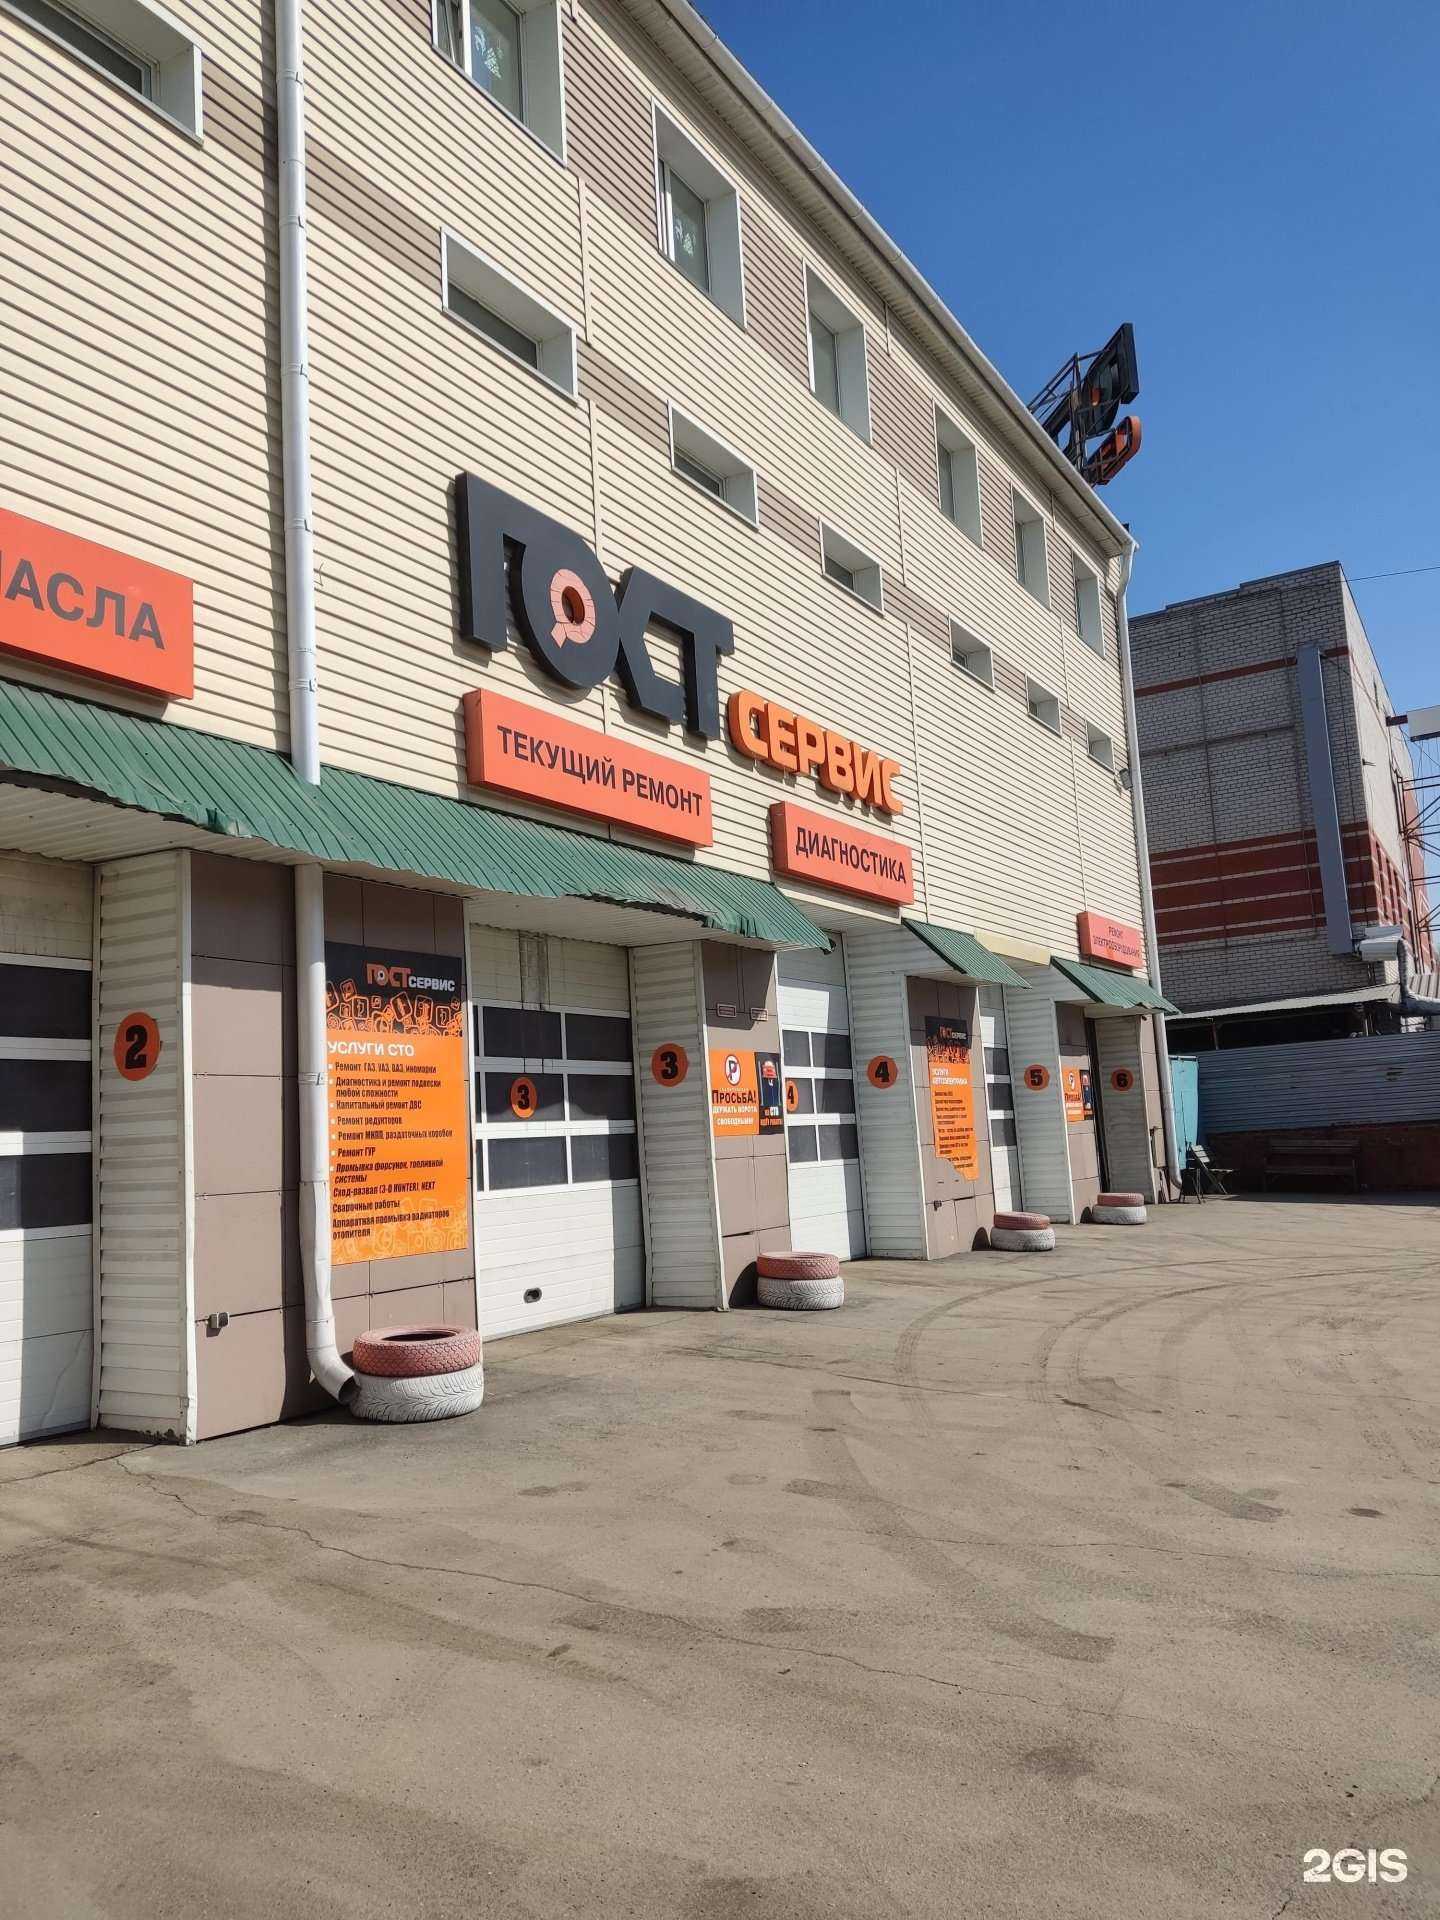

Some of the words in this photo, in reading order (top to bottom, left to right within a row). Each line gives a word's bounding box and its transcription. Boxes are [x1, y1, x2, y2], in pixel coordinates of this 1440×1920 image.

[0, 551, 165, 649] АСЛА
[455, 470, 734, 741] ГОСТ
[728, 689, 904, 816] СЕРВИС
[497, 724, 616, 790] ТЕКУЩИЙ
[622, 768, 703, 817] РЕМОНТ
[795, 826, 908, 885] ДИАГНОСТИКА
[408, 976, 456, 992] СЕРВИС
[125, 1025, 148, 1069] 2
[328, 1041, 385, 1056] УСЛУГИ
[387, 1044, 415, 1057] СТО
[335, 1062, 362, 1072] Ремонт
[660, 1050, 679, 1076] 3
[874, 1061, 891, 1083] 4
[1030, 1069, 1042, 1086] 5
[1117, 1072, 1128, 1088] 6
[336, 1077, 381, 1088] Диагностика
[387, 1078, 410, 1088] ремонт
[411, 1079, 442, 1089] подвески
[336, 1088, 361, 1098] любой
[362, 1088, 399, 1098] сложности
[517, 1084, 530, 1110] 3
[336, 1100, 385, 1110] Капитальный
[386, 1101, 409, 1111] ремонт
[409, 1100, 422, 1111] ДВС
[337, 1116, 364, 1126] Ремонт
[365, 1116, 402, 1127] редукторов
[338, 1131, 364, 1141] Ремонт
[385, 1130, 427, 1141] раздаточных
[337, 1148, 364, 1158] Ремонт
[365, 1147, 376, 1157] ГУР
[336, 1163, 374, 1173] Промывка
[409, 1158, 444, 1169] топливной
[334, 1174, 368, 1185] системы
[332, 1202, 373, 1214] Сварочные
[374, 1200, 400, 1211] работы
[332, 1228, 371, 1241] отопителя
